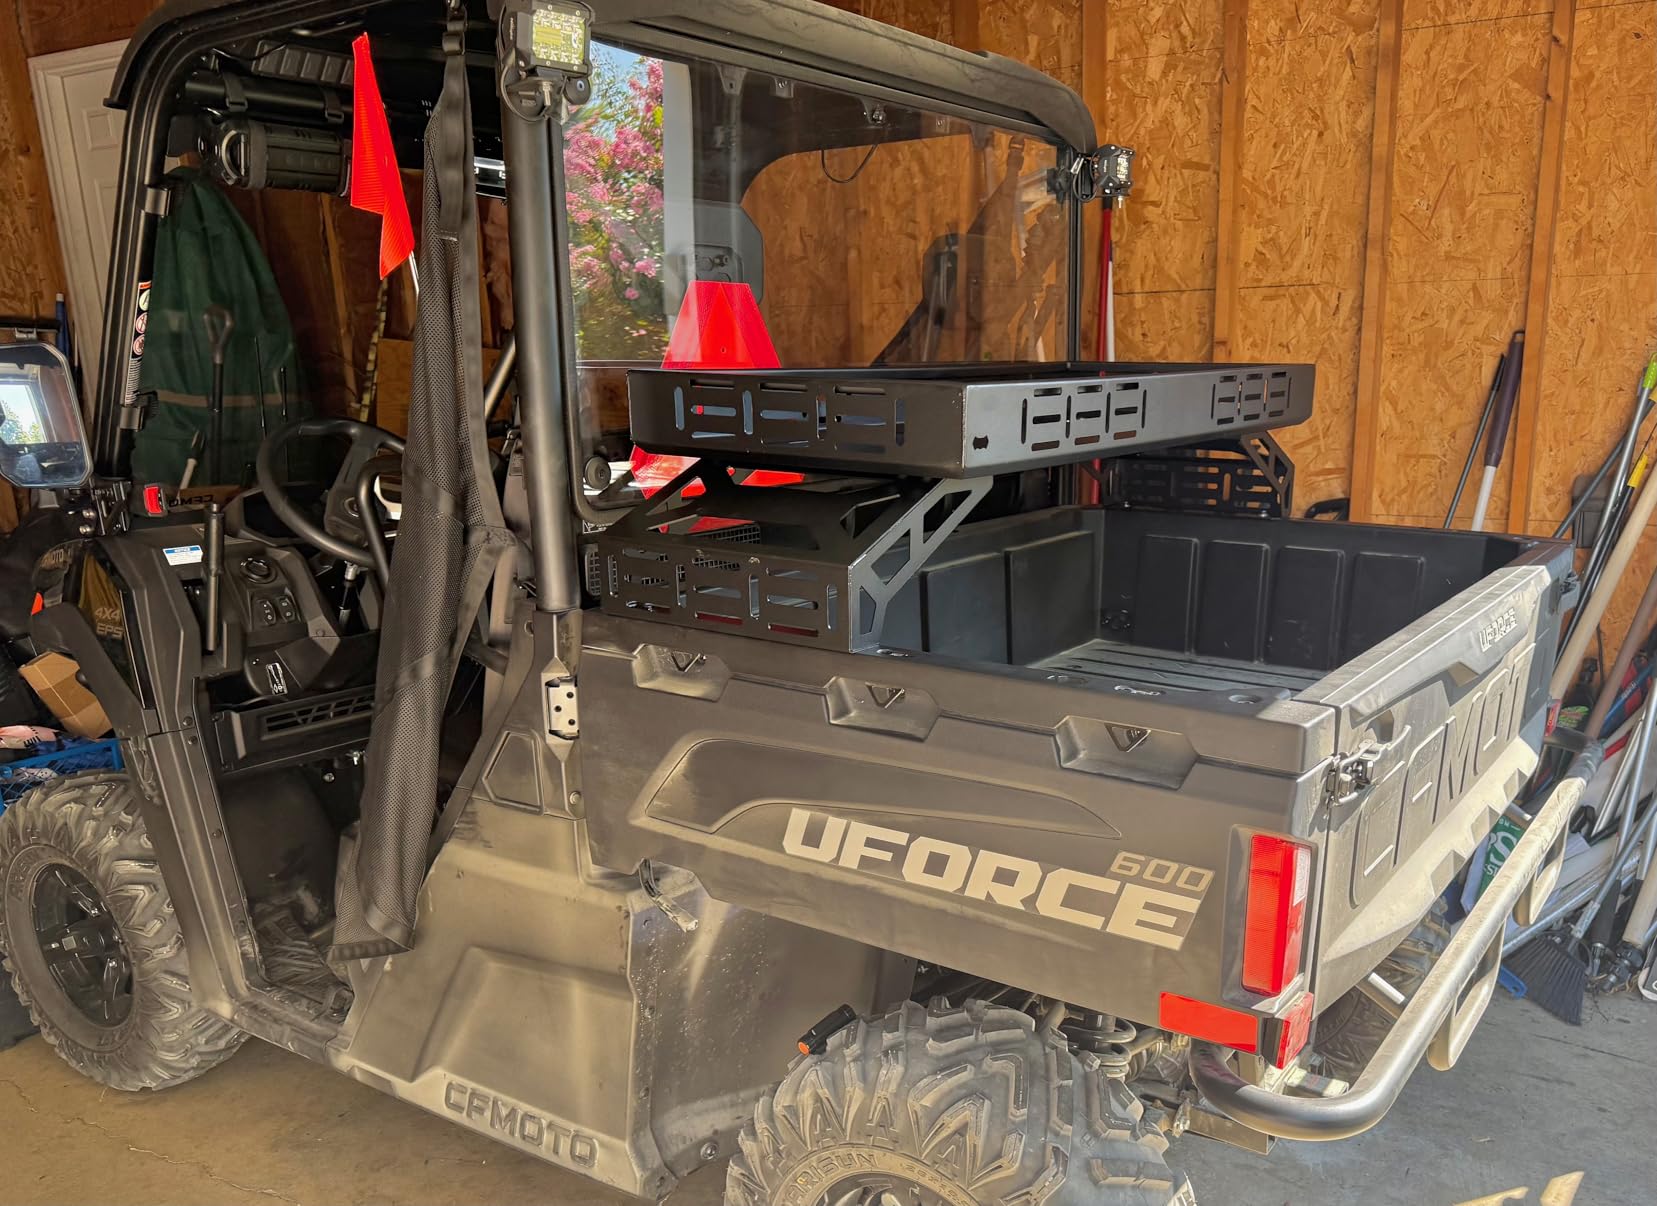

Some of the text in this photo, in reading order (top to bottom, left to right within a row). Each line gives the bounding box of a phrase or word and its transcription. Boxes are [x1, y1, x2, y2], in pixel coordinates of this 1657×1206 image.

[95, 607, 121, 620] 4X4
[96, 622, 124, 639] EPS
[782, 807, 1201, 951] UFORCE
[1110, 851, 1216, 892] 600
[444, 1080, 600, 1169] CFMOTO
